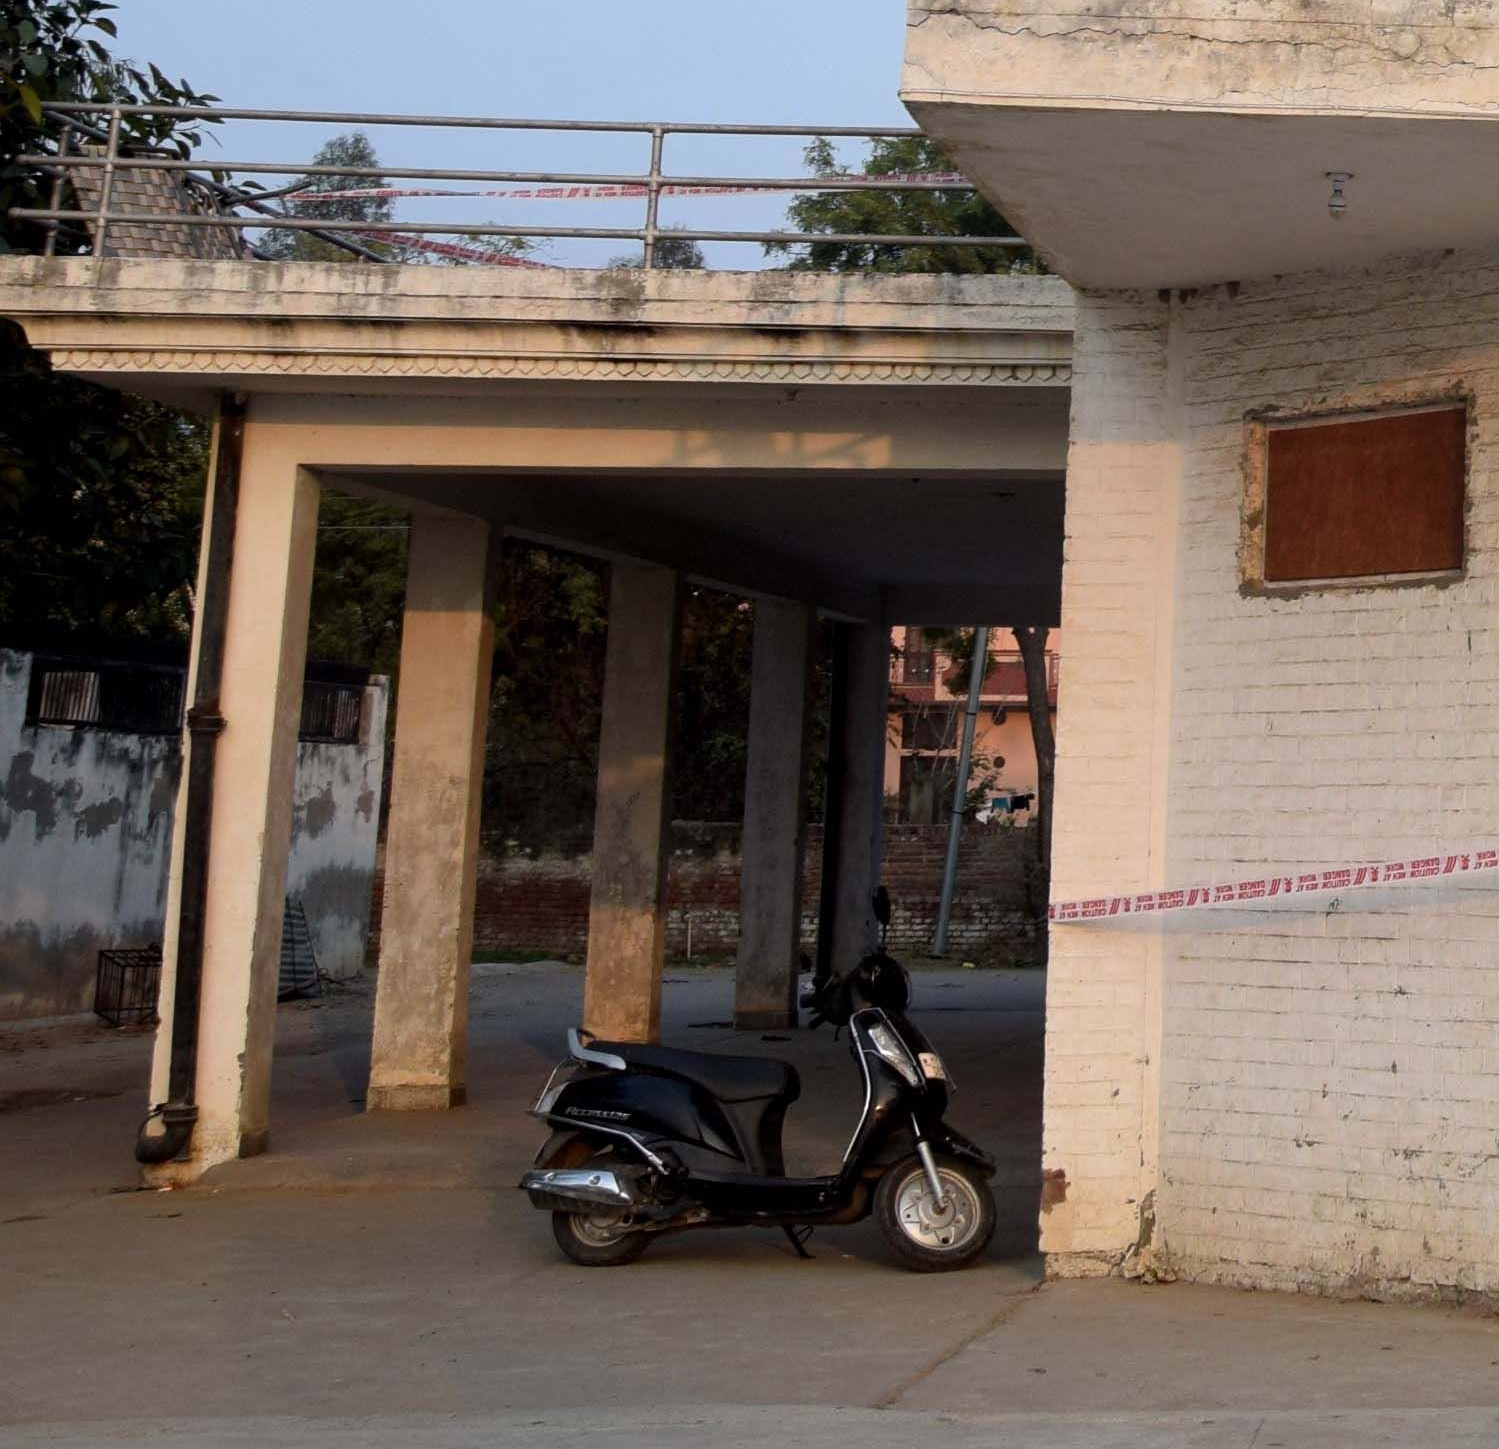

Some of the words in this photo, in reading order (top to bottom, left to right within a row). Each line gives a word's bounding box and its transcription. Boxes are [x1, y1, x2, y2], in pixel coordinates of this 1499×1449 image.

[1477, 849, 1496, 860] WORK
[1387, 862, 1404, 872] WORK
[1411, 857, 1439, 869] DANGER
[1474, 860, 1483, 869] AT
[1486, 858, 1498, 868] MEN
[1323, 869, 1350, 880] DANGER
[1393, 871, 1406, 879] MEN
[1412, 866, 1439, 877] CAUTION
[1299, 873, 1316, 883] WORK
[1383, 873, 1391, 881] AT
[1239, 879, 1265, 890] DANGER
[1296, 883, 1304, 891] AT
[1306, 881, 1318, 890] MEN
[1322, 878, 1350, 888] CAUTION
[1216, 883, 1233, 894] WORK
[1239, 888, 1265, 898] CAUTION
[1137, 894, 1150, 903] WORK
[1159, 890, 1183, 901] DANGER
[1214, 894, 1221, 902] AT
[1222, 892, 1234, 901] MEN
[1062, 902, 1076, 911] WORK
[1083, 899, 1106, 908] DANGER
[1135, 903, 1141, 911] AT
[1143, 901, 1154, 910] MEN
[1158, 898, 1183, 908] CAUTION
[1058, 911, 1065, 919] AT
[1067, 910, 1078, 918] MEN
[1082, 907, 1106, 917] CAUTION
